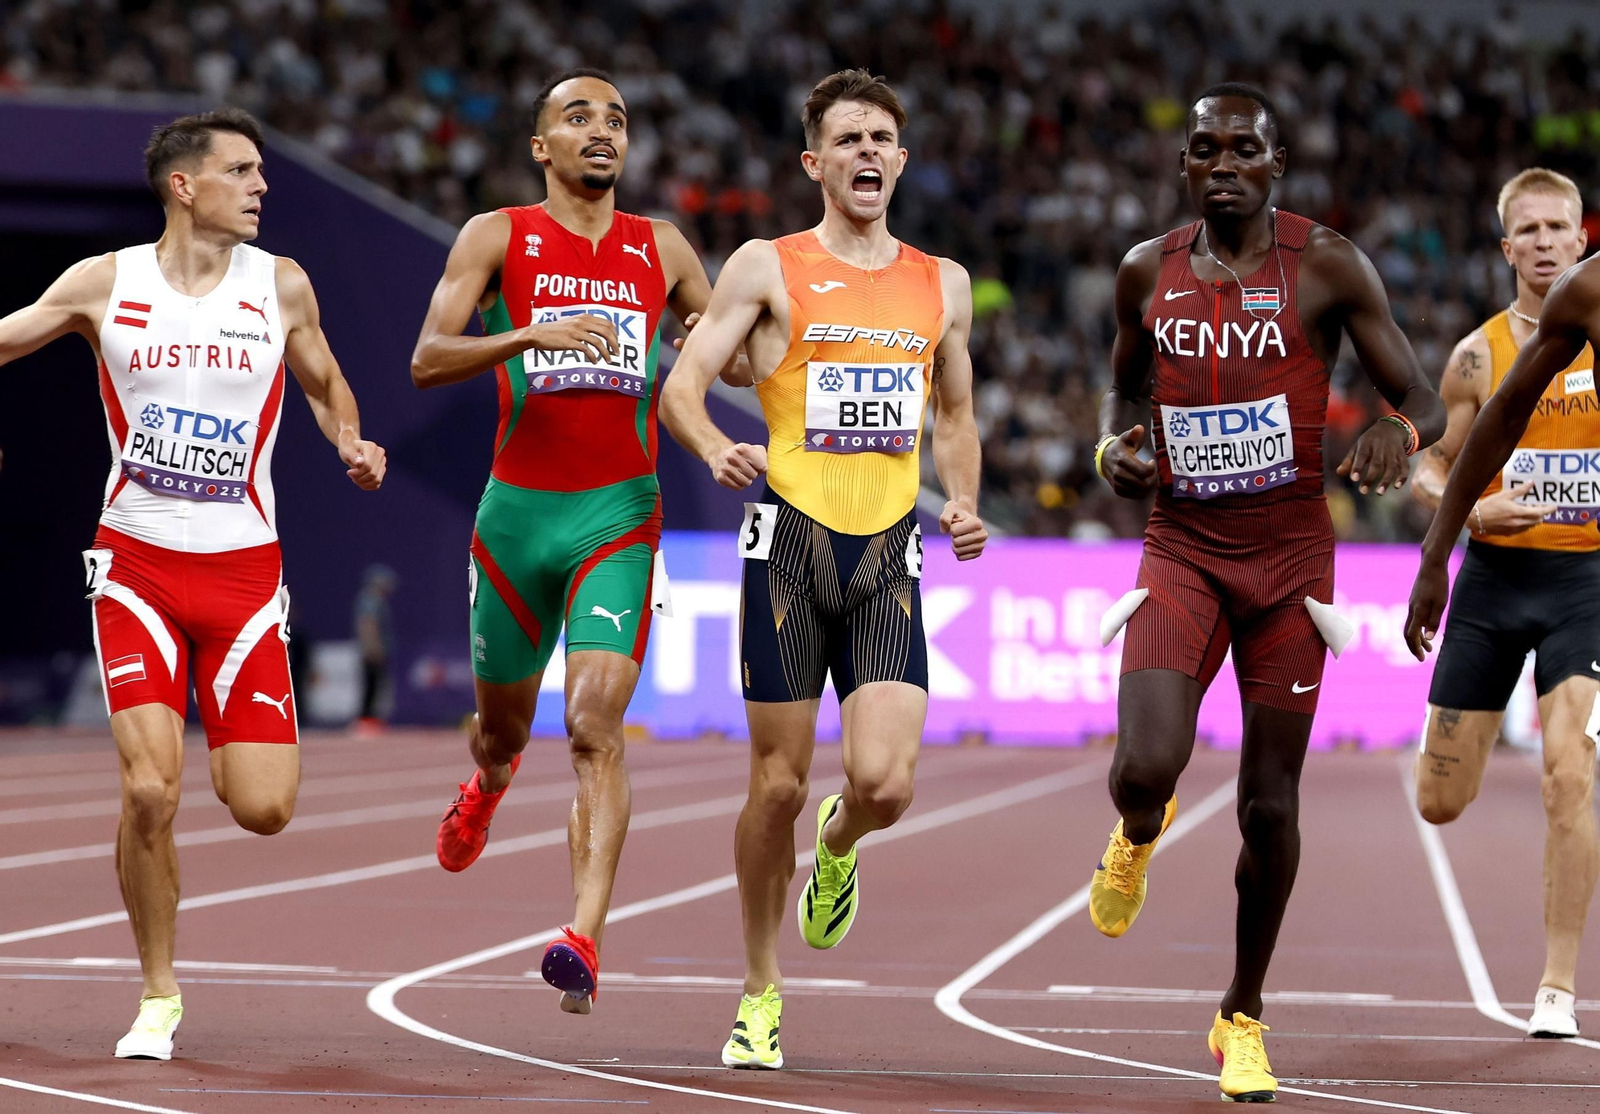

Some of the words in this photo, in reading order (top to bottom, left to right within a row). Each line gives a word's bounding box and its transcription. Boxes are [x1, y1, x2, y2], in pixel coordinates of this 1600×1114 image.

[534, 274, 643, 305] PORTUGAL
[219, 328, 260, 341] helvetia
[802, 323, 930, 355] ESPAÑA
[1154, 317, 1287, 358] KENYA
[128, 344, 253, 374] AUSTRIA
[844, 367, 916, 393] TDK
[1566, 375, 1592, 388] WGV
[166, 407, 250, 445] TDK
[838, 401, 902, 427] BEN
[1188, 402, 1280, 437] TDK
[130, 432, 248, 477] PALLITSCH
[1184, 432, 1287, 473] CHERUIYOT
[1536, 453, 1600, 475] TDK
[746, 513, 762, 551] 5
